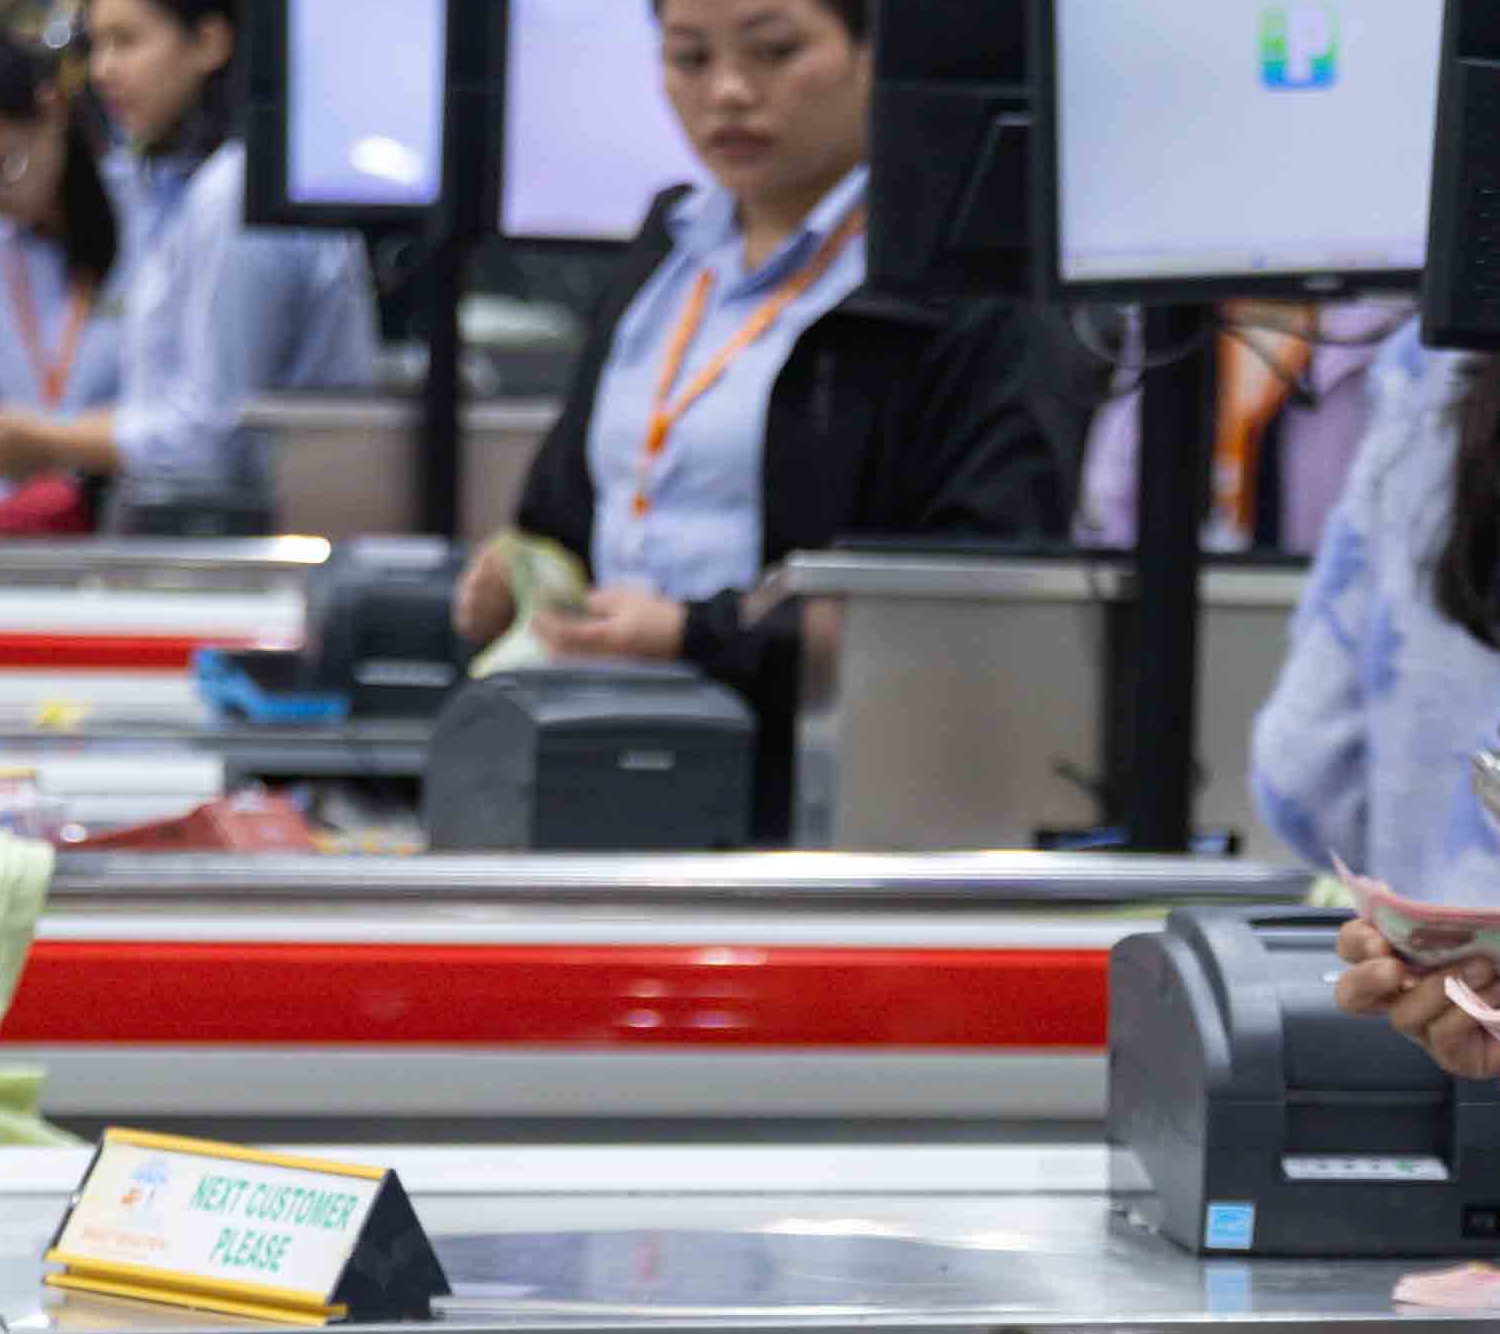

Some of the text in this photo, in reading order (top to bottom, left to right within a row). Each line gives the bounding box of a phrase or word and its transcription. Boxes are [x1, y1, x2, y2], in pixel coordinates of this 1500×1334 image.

[190, 1176, 359, 1229] NEXT CUSTOMER
[211, 1228, 292, 1272] PLEASE
